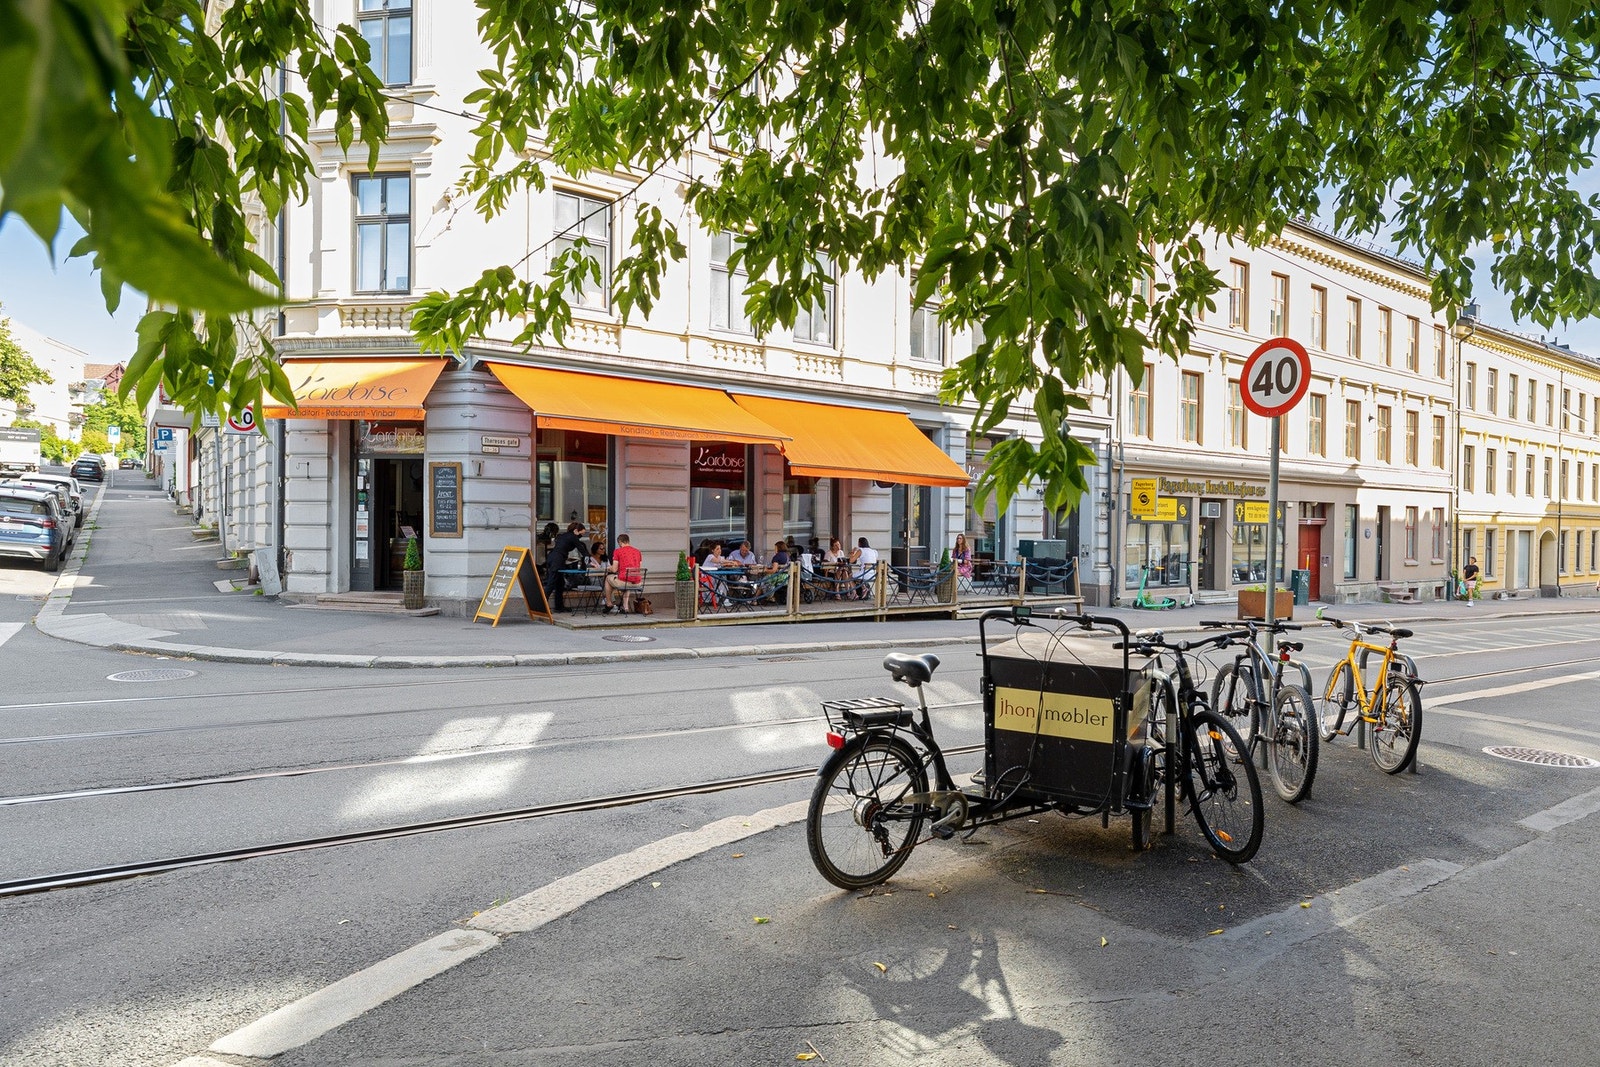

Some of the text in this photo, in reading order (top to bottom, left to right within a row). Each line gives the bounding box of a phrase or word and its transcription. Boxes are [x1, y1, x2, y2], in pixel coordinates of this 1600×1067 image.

[1252, 356, 1298, 397] 40
[325, 409, 365, 417] Restaurant
[371, 409, 396, 417] Vinbar
[161, 430, 169, 440] P
[998, 697, 1109, 727] jhon møbler
